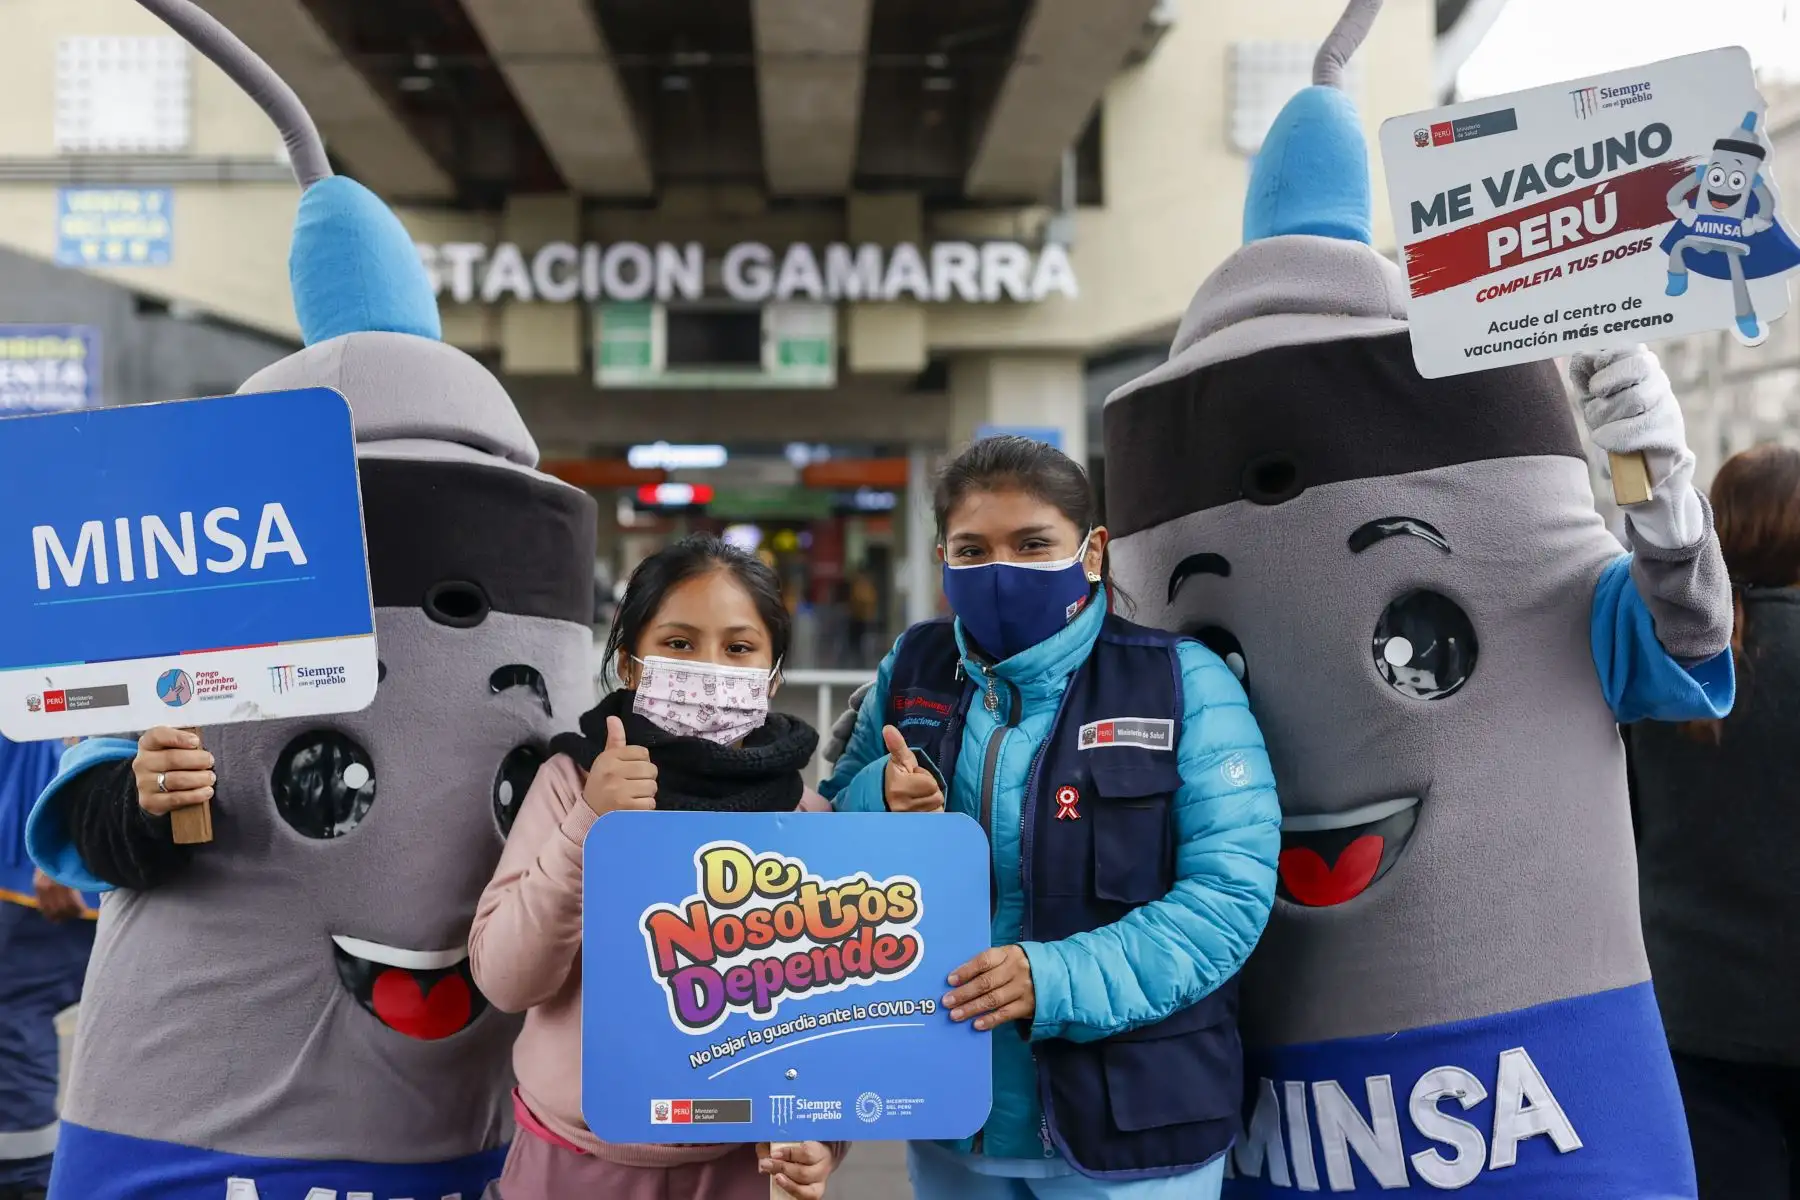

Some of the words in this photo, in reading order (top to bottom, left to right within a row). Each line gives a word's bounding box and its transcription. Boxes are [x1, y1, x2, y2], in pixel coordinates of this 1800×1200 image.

[1600, 81, 1651, 99] Siempre
[1619, 92, 1653, 108] pueblo
[1434, 128, 1451, 138] PERÚ
[1456, 123, 1481, 133] Ministerio
[1464, 129, 1478, 137] Salud
[1410, 183, 1474, 235] ME
[1481, 122, 1672, 208] VACUNO
[1487, 181, 1618, 269] PERÚ
[1695, 221, 1743, 238] MINSA
[722, 241, 1078, 301] GAMARRA
[1475, 265, 1563, 303] COMPLETA
[1567, 253, 1599, 275] TUS
[1601, 237, 1654, 264] DOSIS
[1488, 314, 1539, 334] Acude
[1543, 309, 1559, 324] al
[1563, 302, 1617, 321] centro
[1621, 296, 1642, 311] de
[1464, 331, 1558, 357] vacunación
[1562, 324, 1599, 341] más
[1603, 312, 1674, 334] cercano
[32, 502, 308, 590] MINSA
[195, 671, 219, 679] Pongo
[297, 666, 345, 678] Siempre
[205, 676, 234, 685] hombro
[315, 675, 346, 687] pueblo
[197, 687, 210, 695] por
[220, 683, 238, 692] Perú
[46, 696, 64, 705] PERÚ
[68, 694, 93, 702] Ministerio
[1117, 728, 1142, 737] Ministerio
[1142, 731, 1149, 739] de
[1149, 731, 1165, 739] Salud
[702, 848, 800, 908] De
[647, 880, 916, 976] Nosotros
[668, 924, 918, 1027] Depende
[689, 1050, 712, 1068] No
[711, 1035, 748, 1058] bajar
[748, 1028, 762, 1045] la
[763, 1013, 817, 1044] guardia
[818, 1007, 851, 1026] ante
[852, 1003, 867, 1020] la
[867, 999, 937, 1018] COVID-19
[673, 1107, 690, 1116] PERÚ
[796, 1098, 842, 1113] Siempre
[812, 1111, 842, 1122] pueblo
[1225, 1046, 1584, 1191] MINSA
